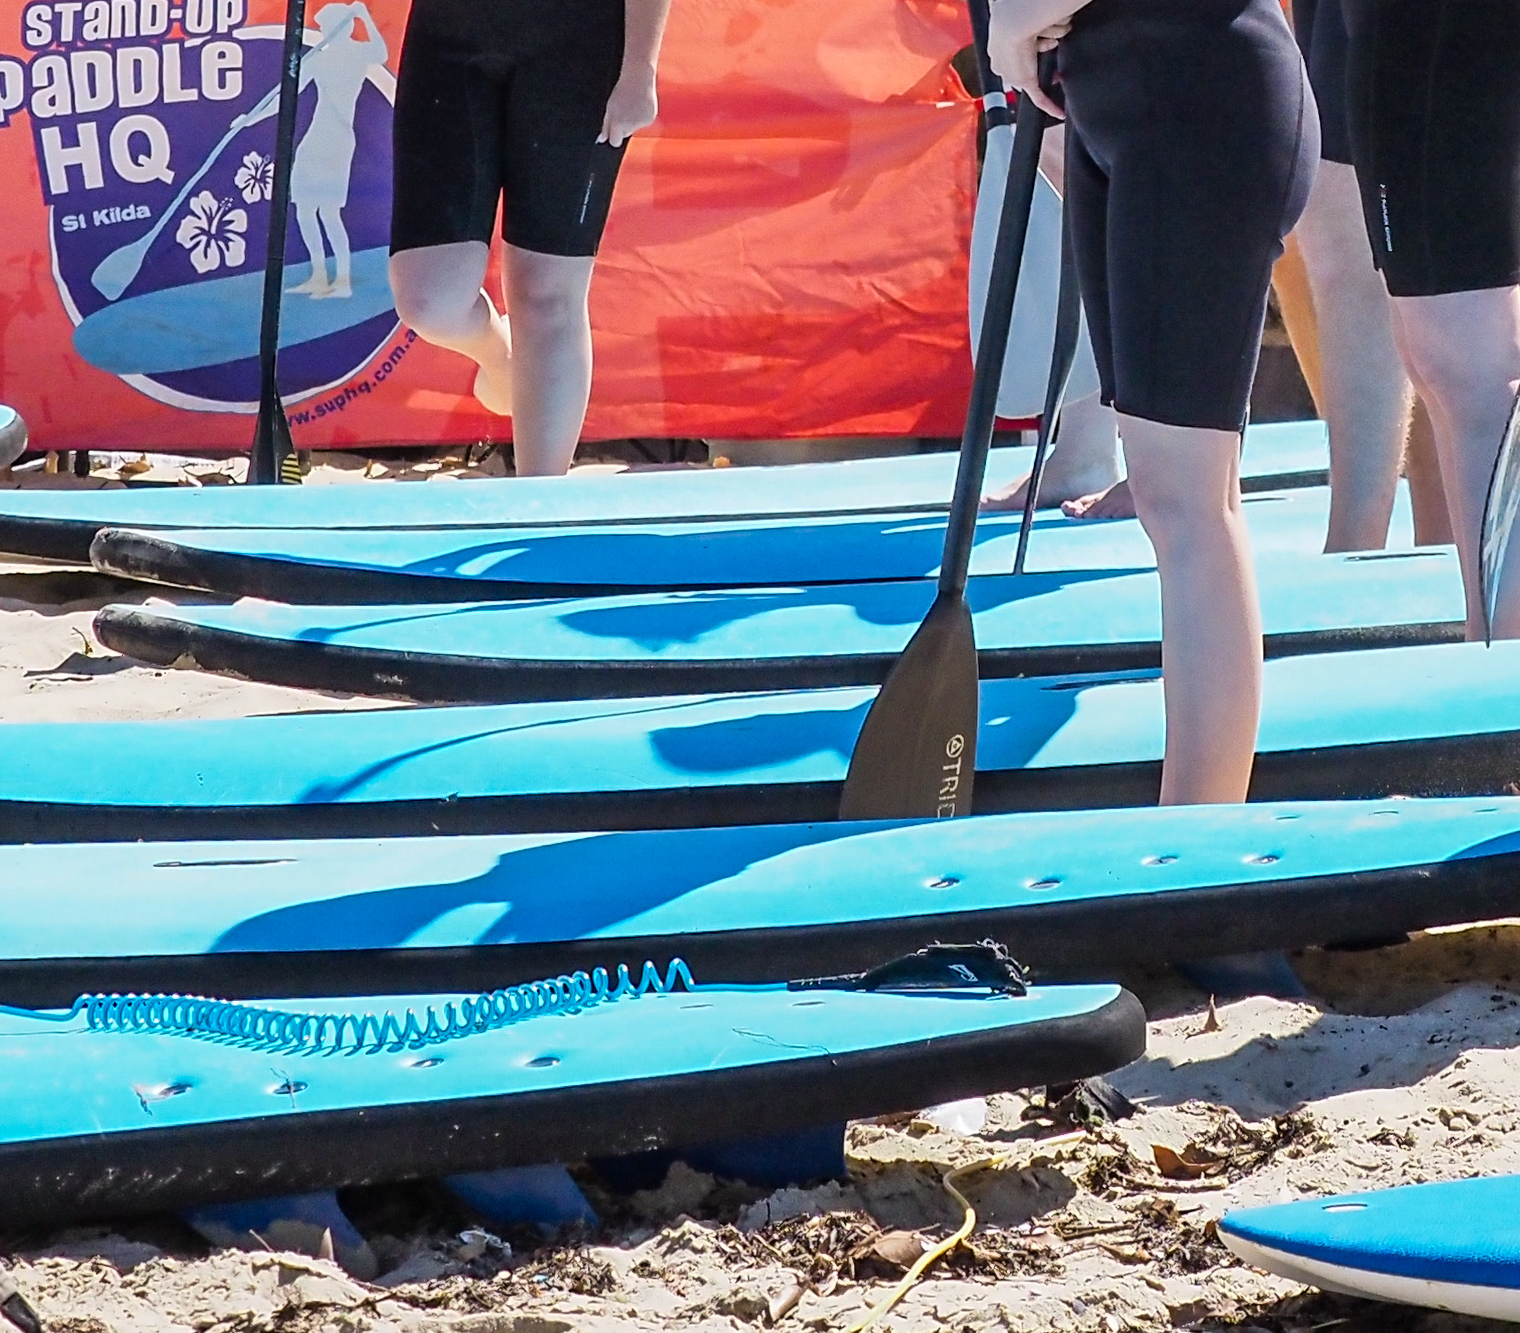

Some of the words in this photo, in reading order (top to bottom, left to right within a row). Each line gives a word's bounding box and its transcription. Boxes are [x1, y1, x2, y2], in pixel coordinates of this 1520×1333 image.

[41, 115, 175, 195] HQ
[94, 204, 151, 226] Kilda
[288, 328, 418, 428] w.suphq.com.a
